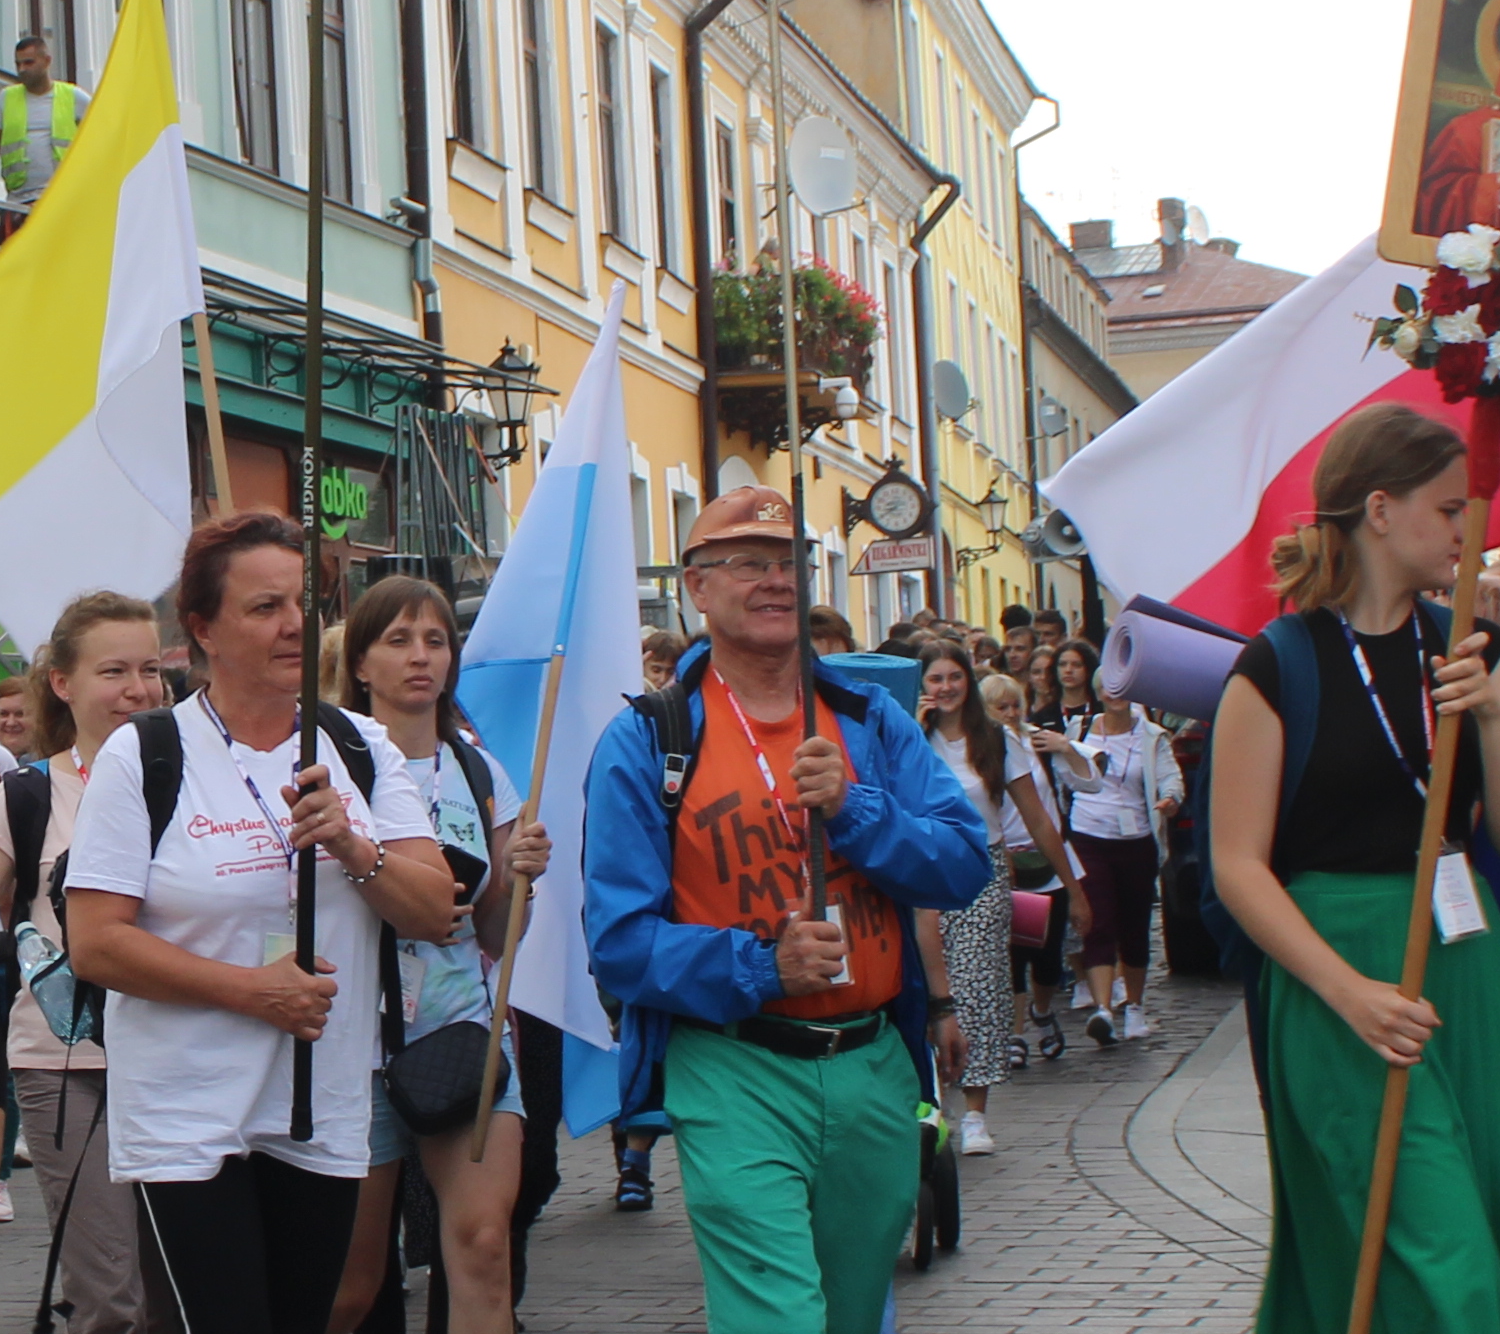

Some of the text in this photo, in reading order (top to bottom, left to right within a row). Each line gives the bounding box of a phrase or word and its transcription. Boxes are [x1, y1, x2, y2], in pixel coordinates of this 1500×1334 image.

[303, 446, 314, 528] KONGER
[321, 466, 368, 519] abka
[187, 814, 266, 839] Chrystus
[695, 790, 807, 885] This
[738, 862, 806, 914] MY
